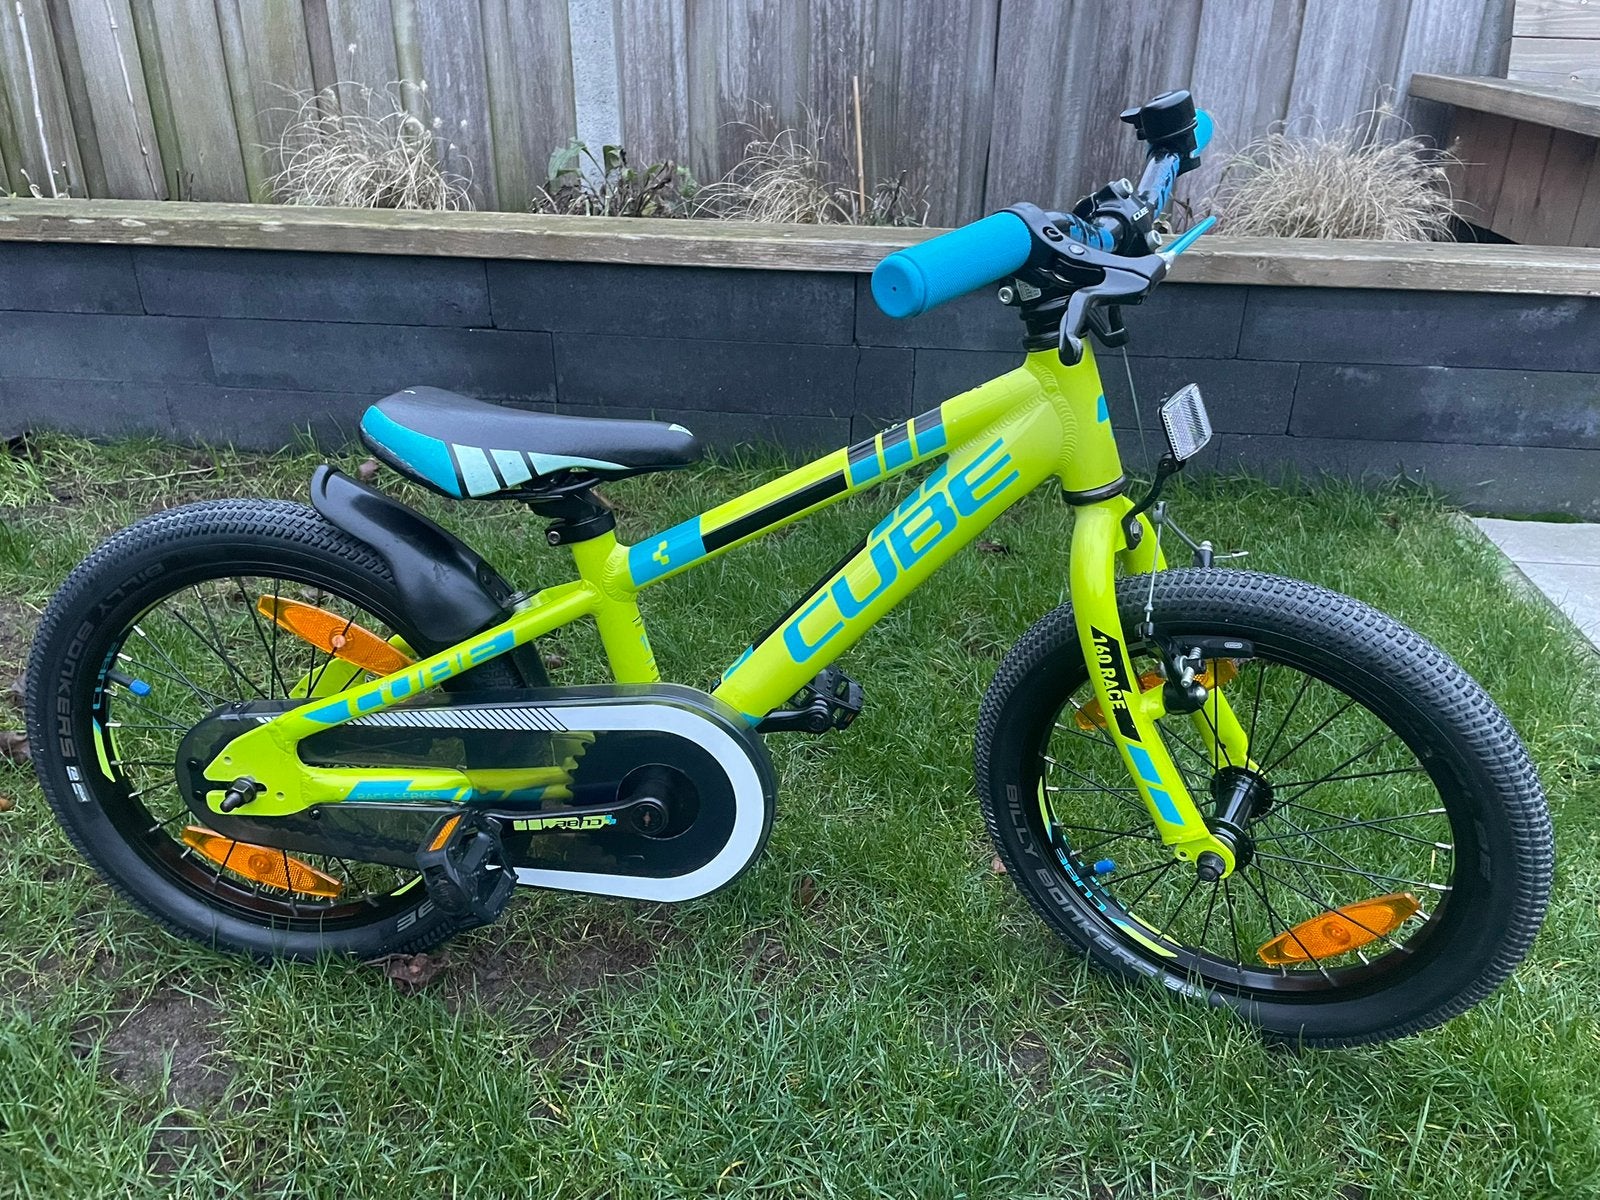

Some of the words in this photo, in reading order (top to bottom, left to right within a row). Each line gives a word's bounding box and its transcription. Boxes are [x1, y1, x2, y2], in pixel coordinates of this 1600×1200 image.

[782, 437, 1020, 663] CUBE
[99, 562, 166, 617] BILLY
[1093, 636, 1113, 664] 160
[57, 620, 95, 757] BONKERS
[1101, 667, 1127, 709] RACE
[356, 791, 389, 800] RACE
[393, 791, 439, 800] SERIES
[1006, 784, 1040, 858] BILLY
[1036, 868, 1158, 977] BONKERS
[1055, 847, 1108, 912] CUBE
